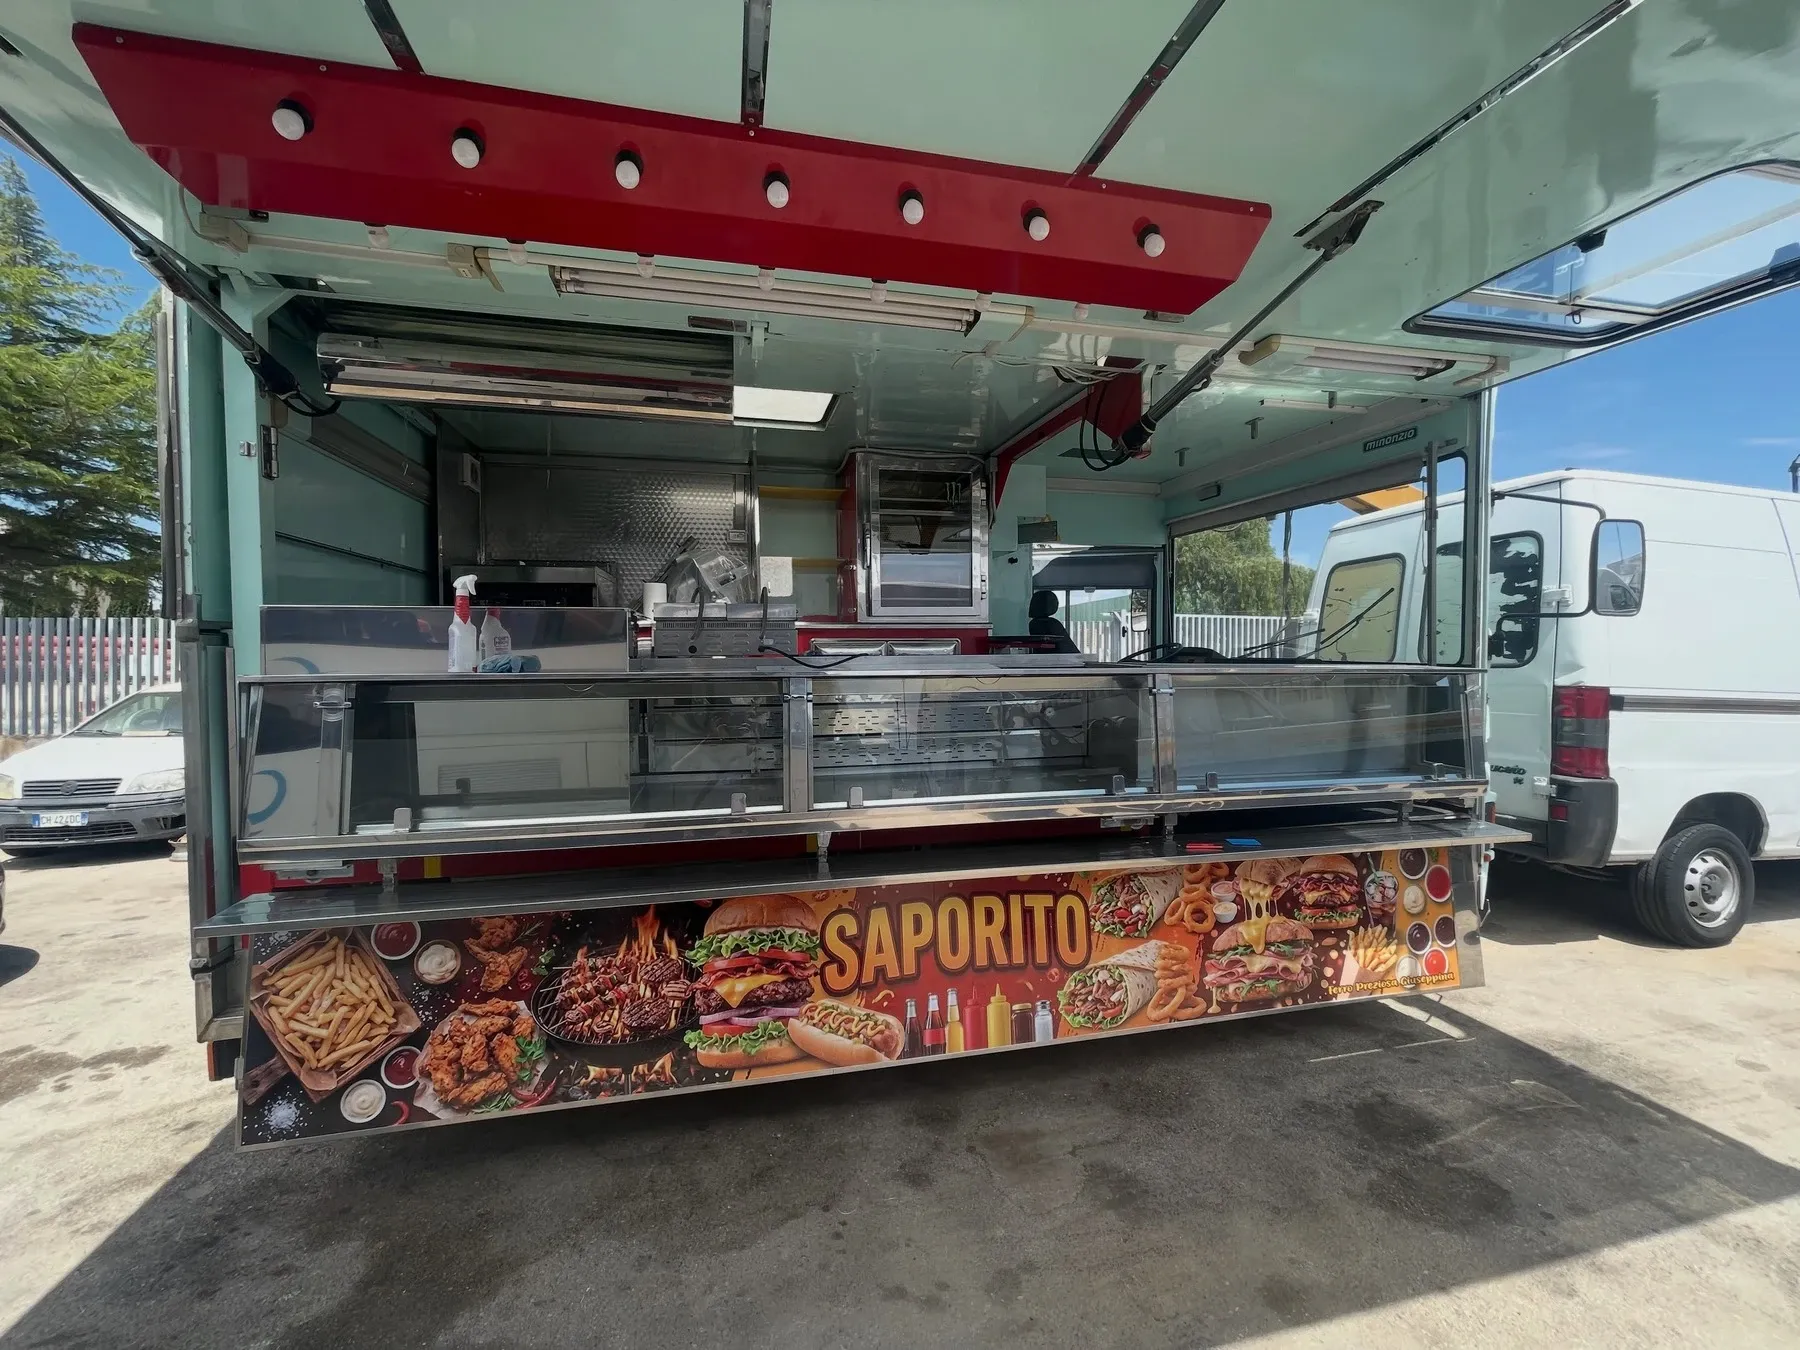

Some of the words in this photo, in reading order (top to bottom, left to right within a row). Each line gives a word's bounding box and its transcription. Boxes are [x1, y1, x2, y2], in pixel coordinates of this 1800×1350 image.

[1490, 764, 1527, 776] ucato
[822, 891, 1090, 994] SAPORITO
[1355, 979, 1399, 992] Preziosa
[1400, 971, 1456, 986] Giuseppina
